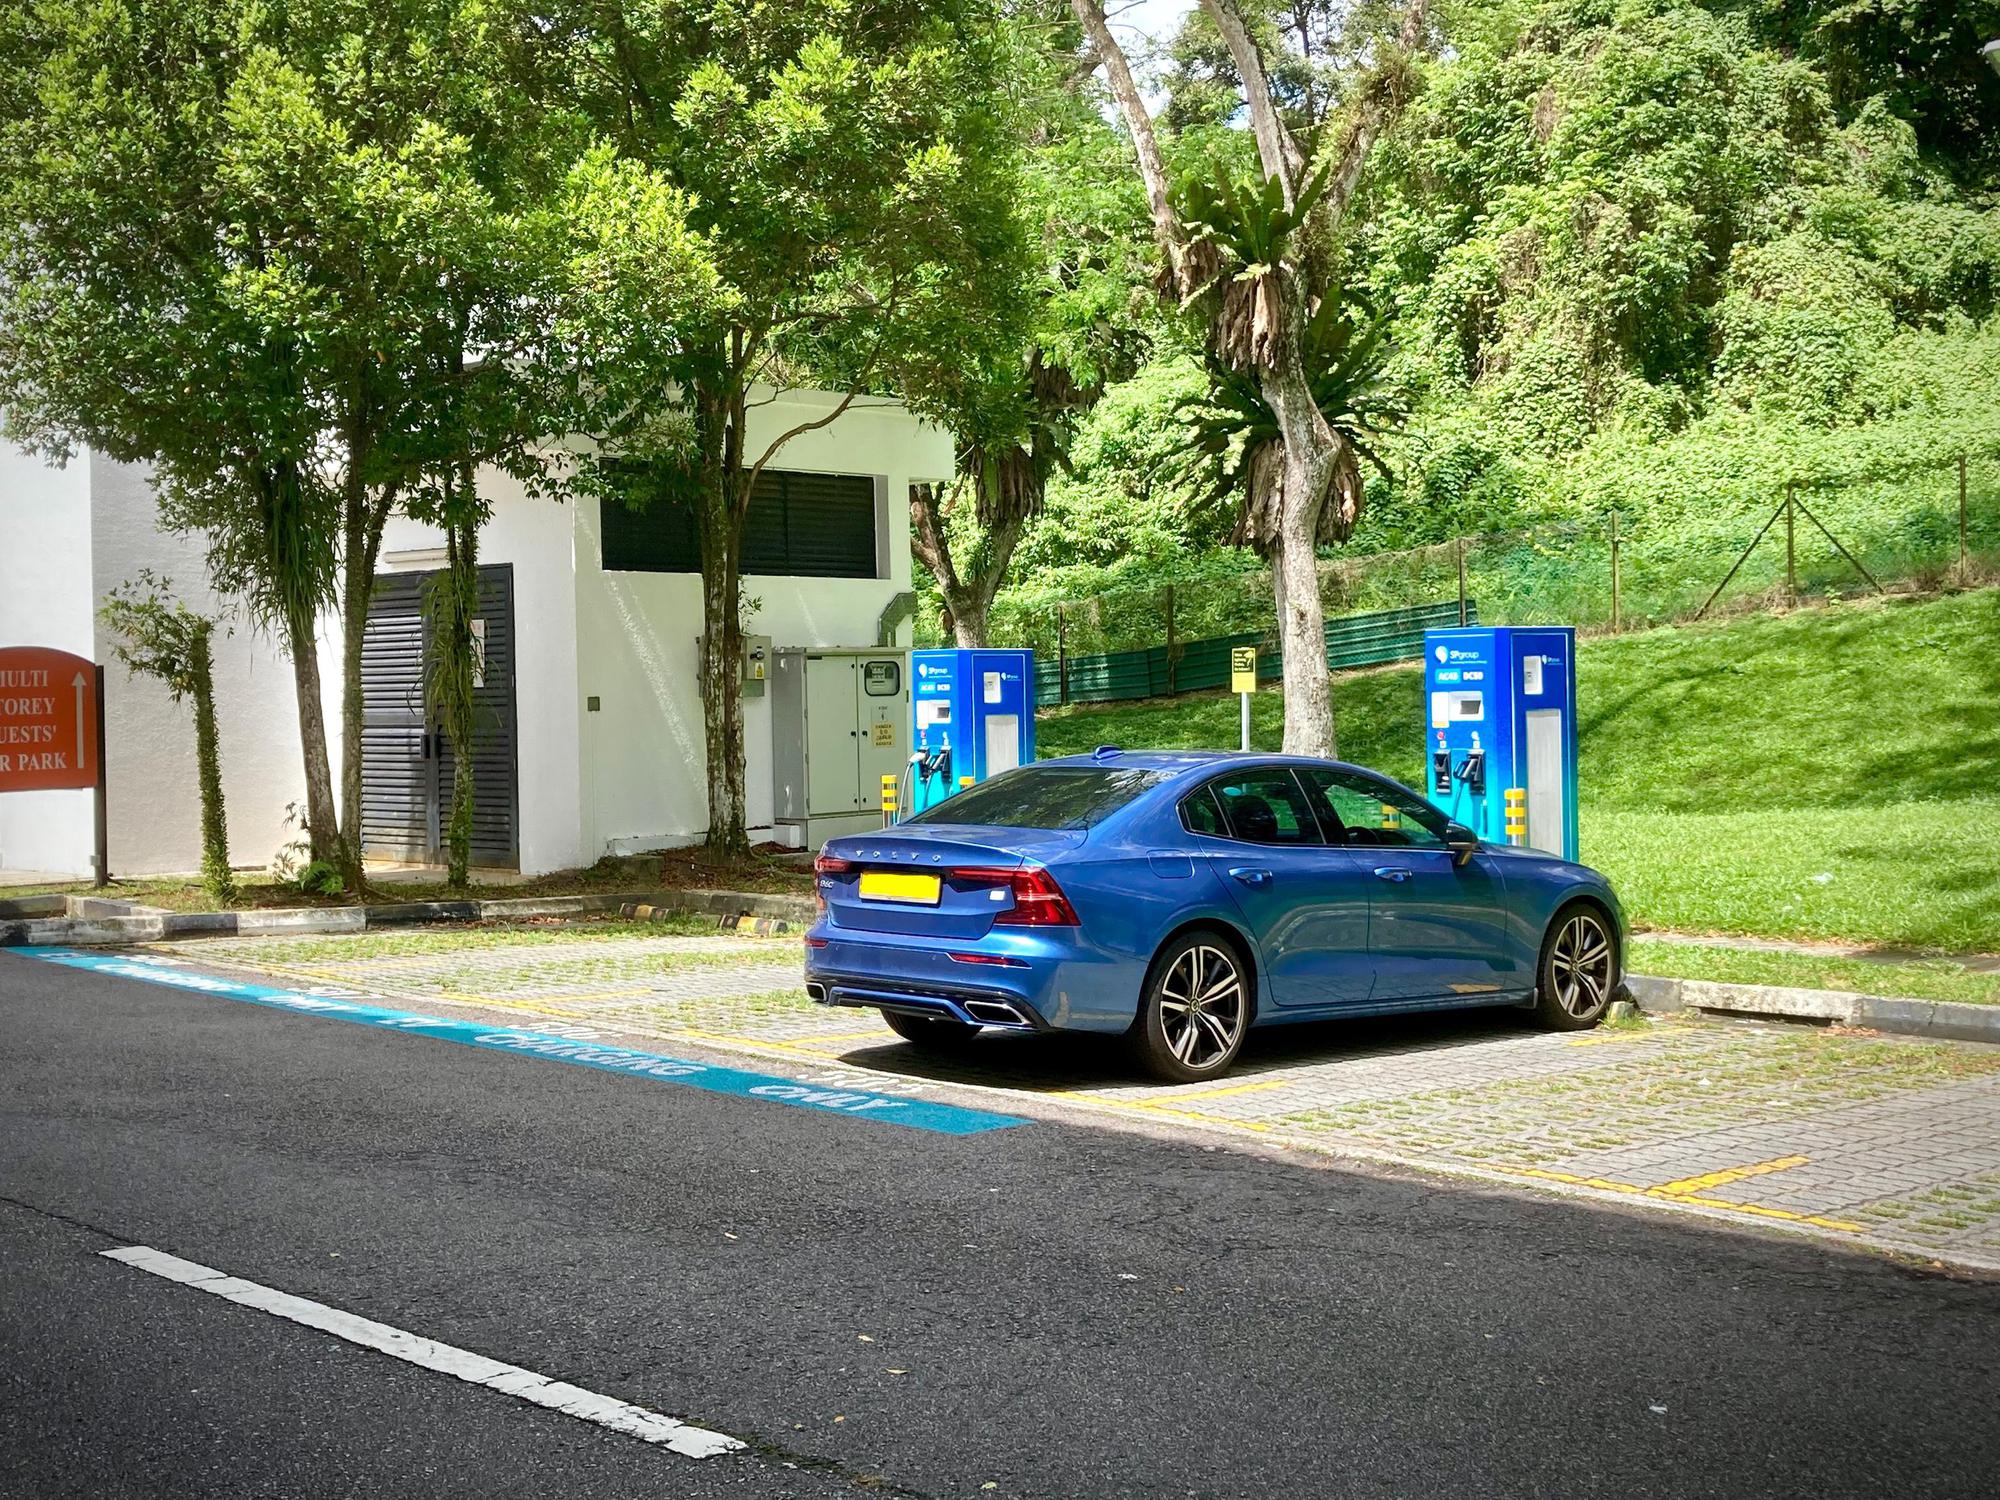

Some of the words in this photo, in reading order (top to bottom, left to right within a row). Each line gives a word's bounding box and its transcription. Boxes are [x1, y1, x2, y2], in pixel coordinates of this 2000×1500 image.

[1450, 650, 1479, 660] SPgroup
[18, 752, 67, 771] PARK
[856, 850, 942, 862] VOLVO
[475, 1034, 708, 1075] CHARGING
[749, 1085, 910, 1111] ONLY
